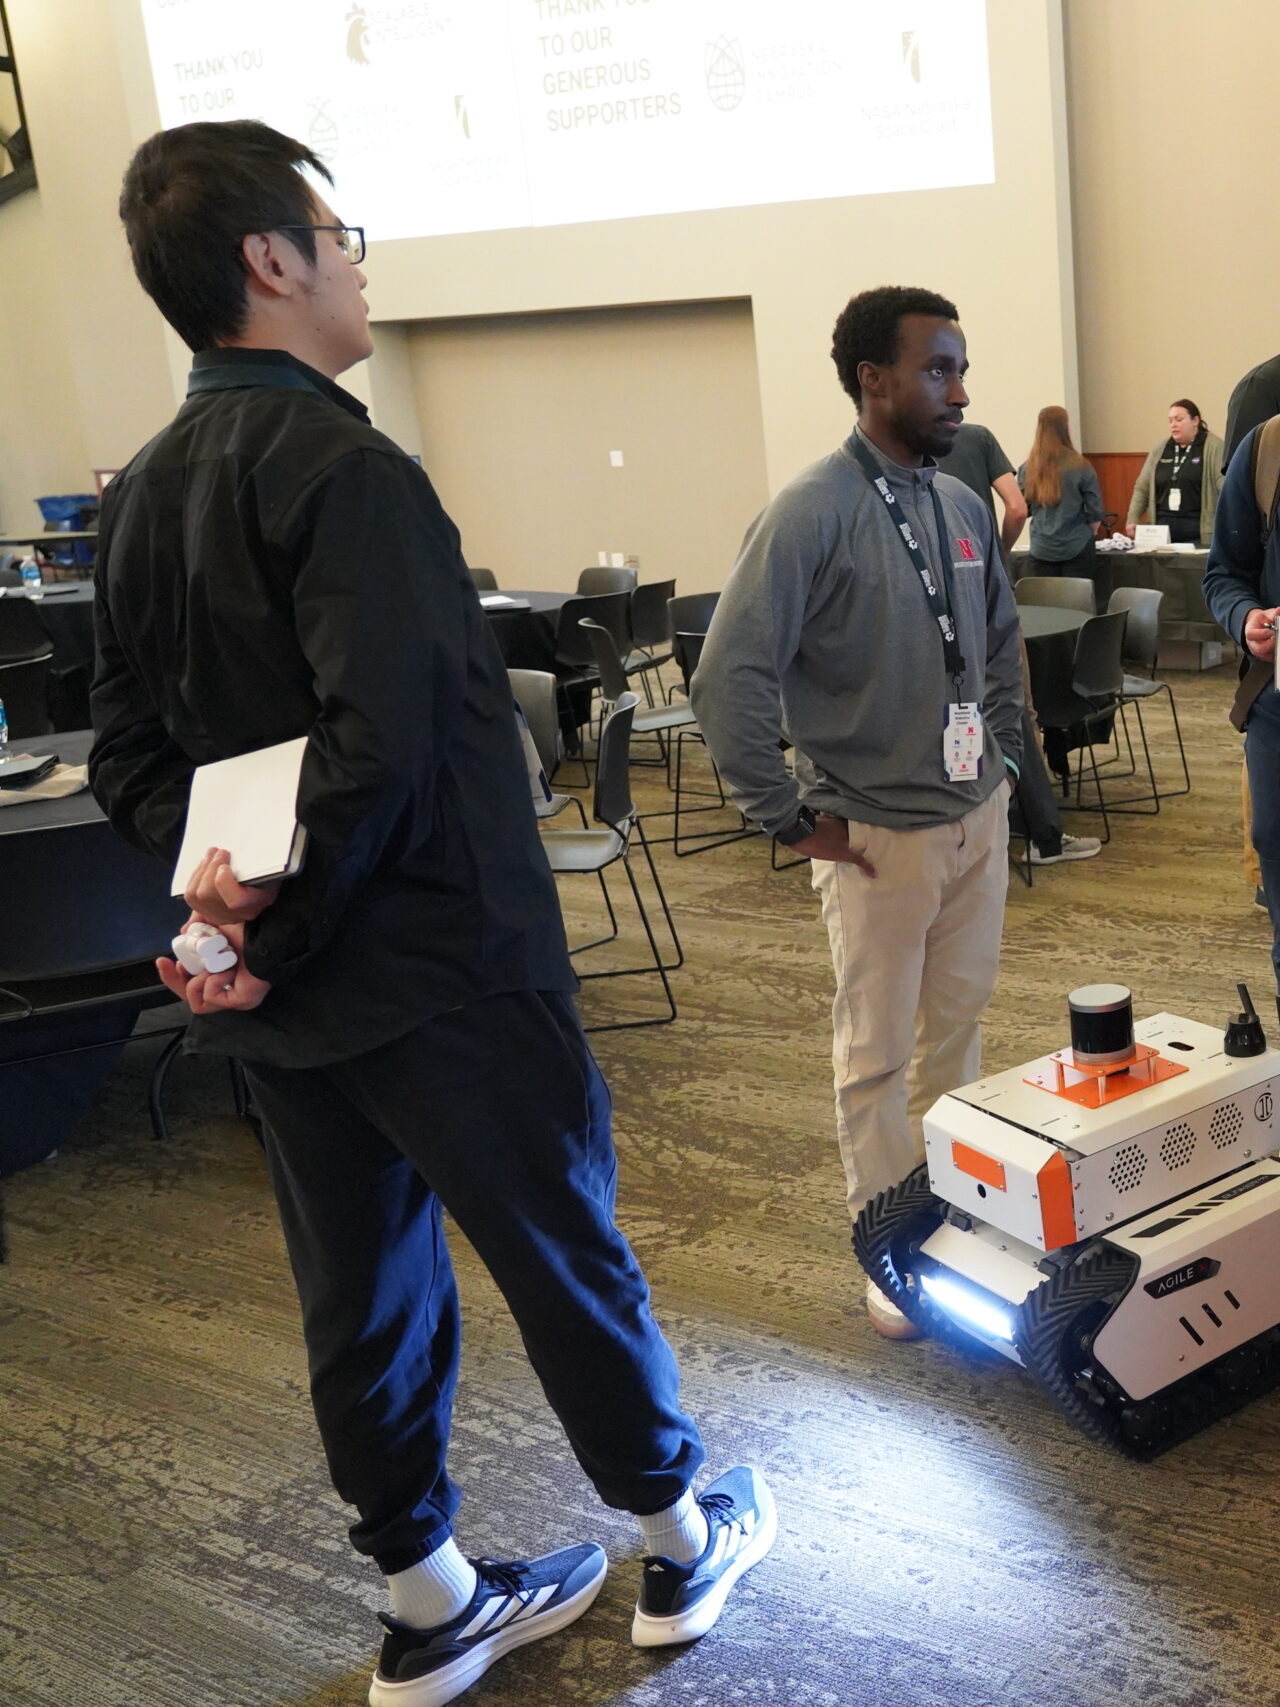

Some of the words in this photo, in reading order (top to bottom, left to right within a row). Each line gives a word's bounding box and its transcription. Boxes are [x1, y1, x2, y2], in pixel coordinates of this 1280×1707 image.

[537, 33, 565, 58] TO
[570, 25, 613, 53] OUR
[172, 55, 228, 83] THANK
[229, 48, 263, 72] YOU
[542, 58, 652, 95] GENEROUS
[178, 93, 200, 115] TO
[203, 88, 236, 111] OUR
[546, 91, 683, 132] SUPPORTERS
[955, 538, 975, 560] N
[1158, 1267, 1194, 1293] AGILE
